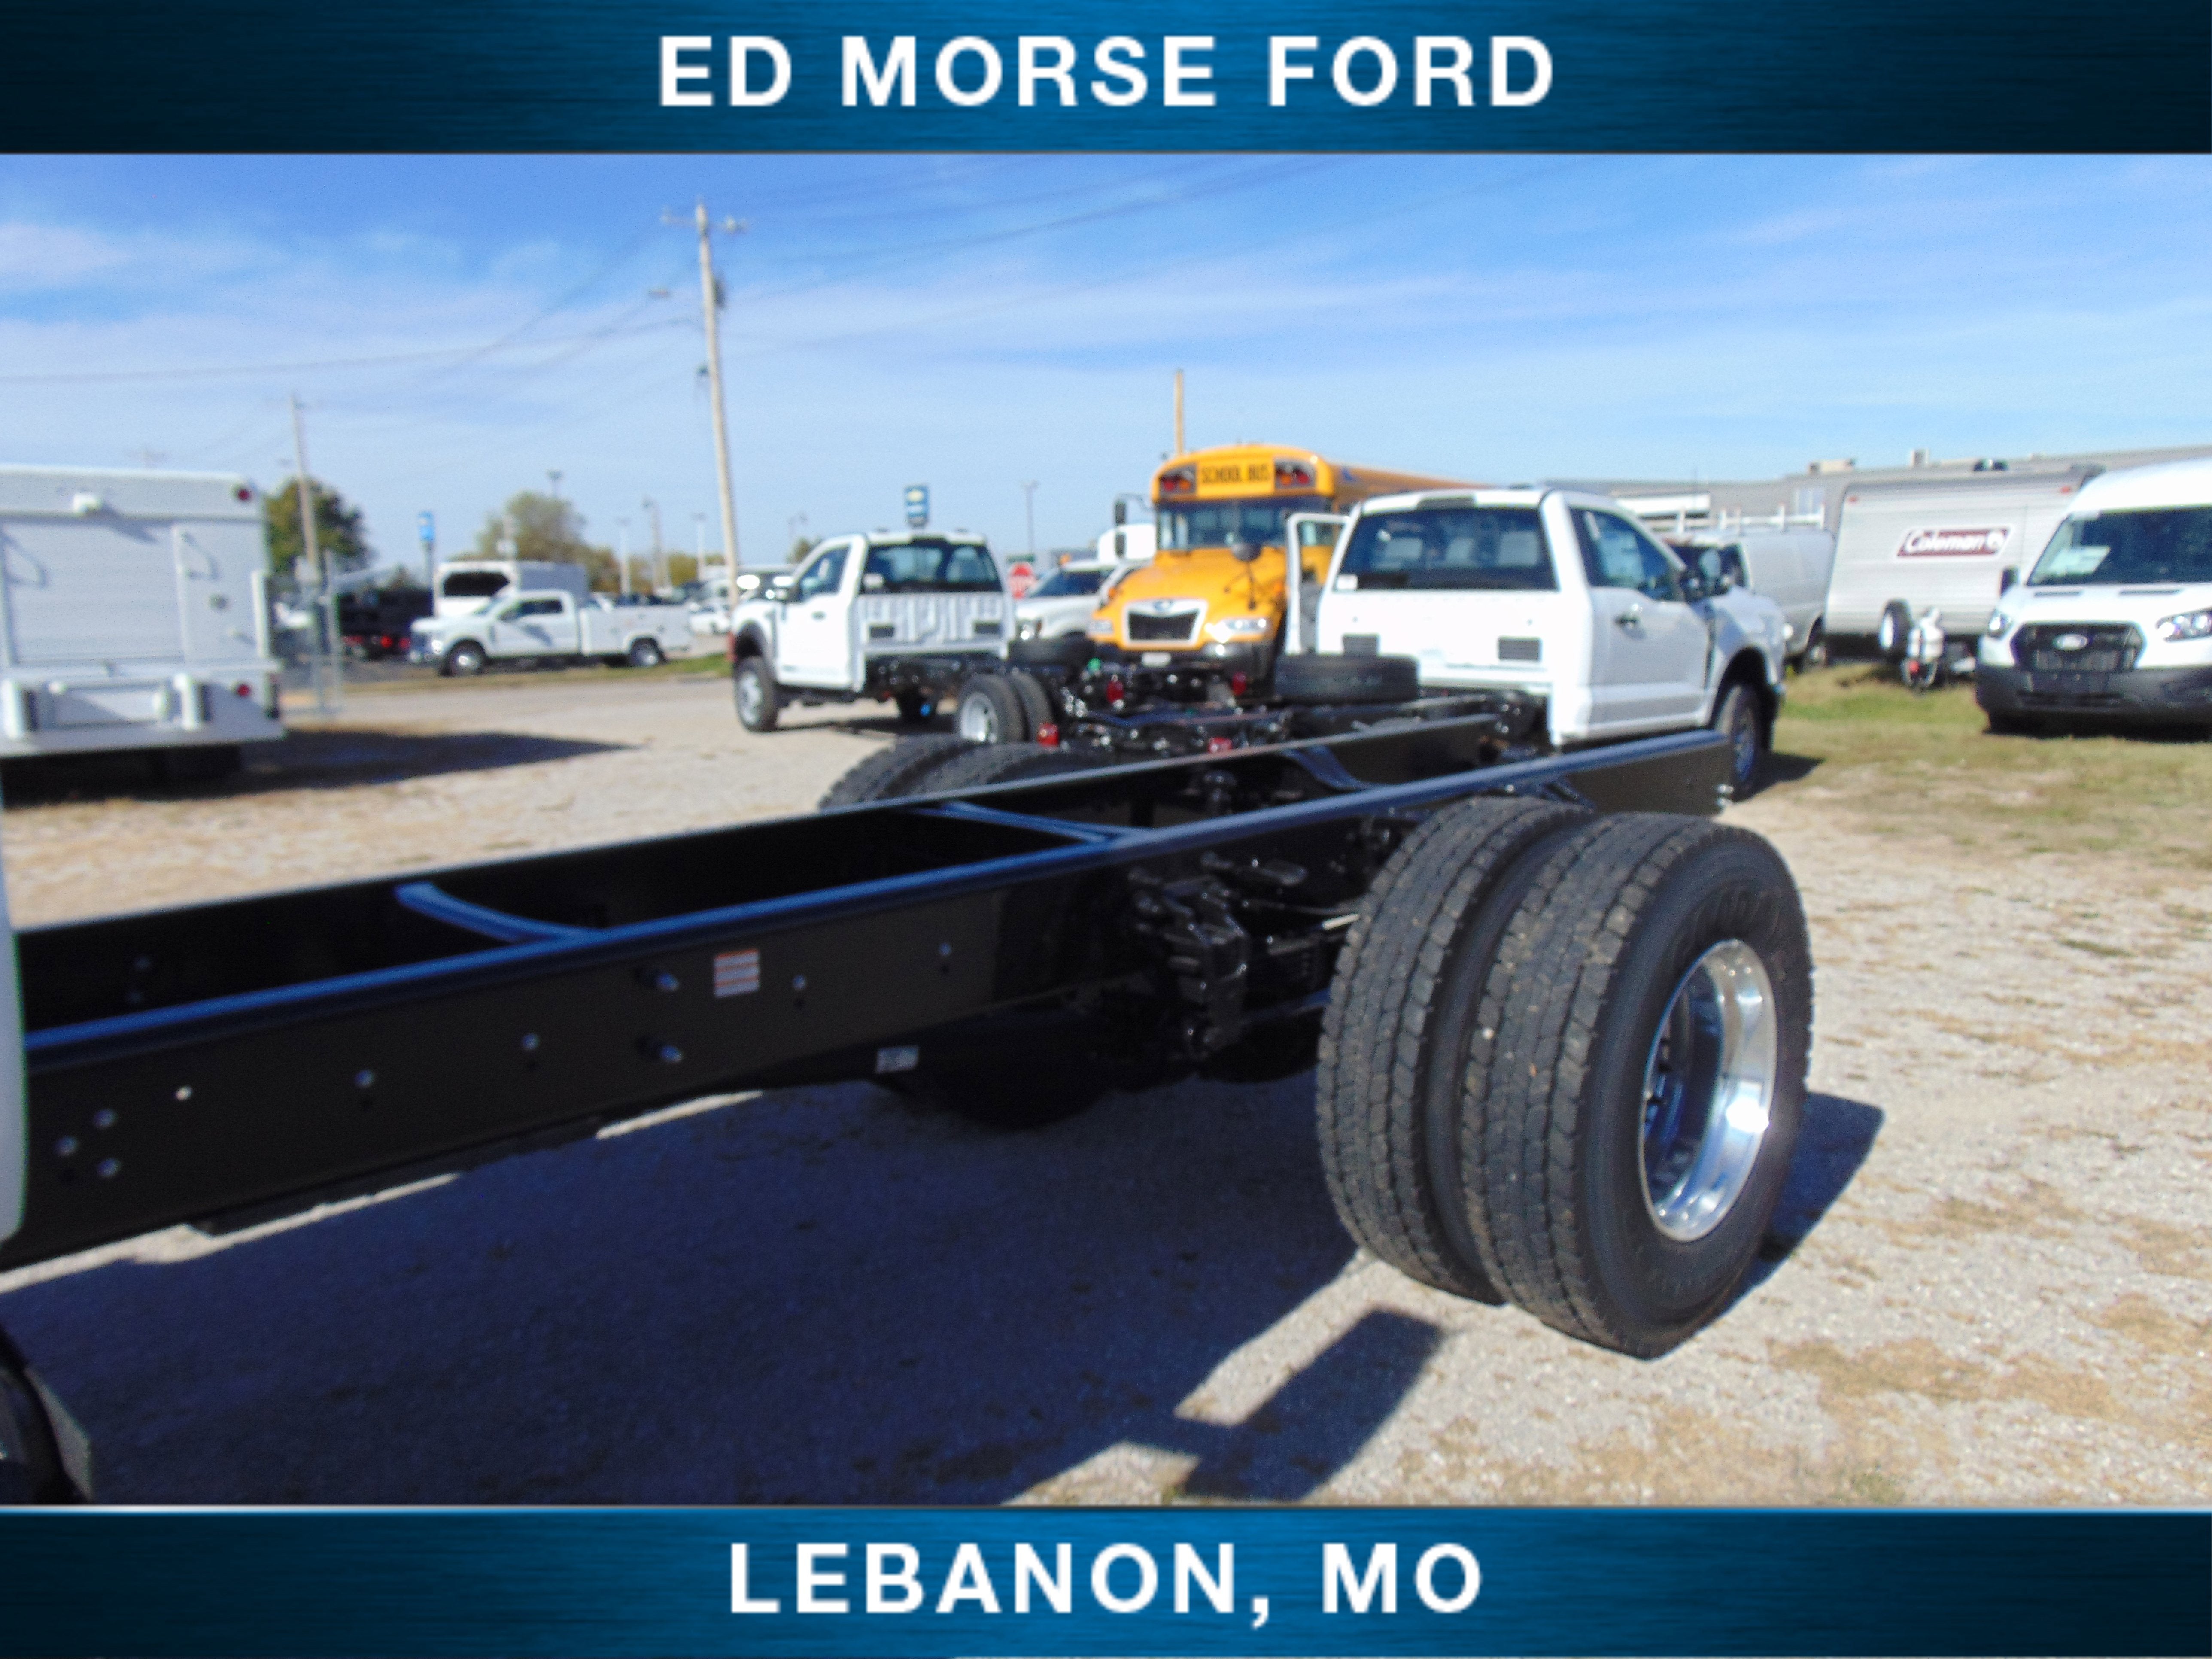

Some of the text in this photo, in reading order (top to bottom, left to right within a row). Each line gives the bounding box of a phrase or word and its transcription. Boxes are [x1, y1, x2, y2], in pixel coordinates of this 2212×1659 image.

[1201, 462, 1270, 484] SCHOOL BUS
[1904, 528, 1986, 553] Coleman
